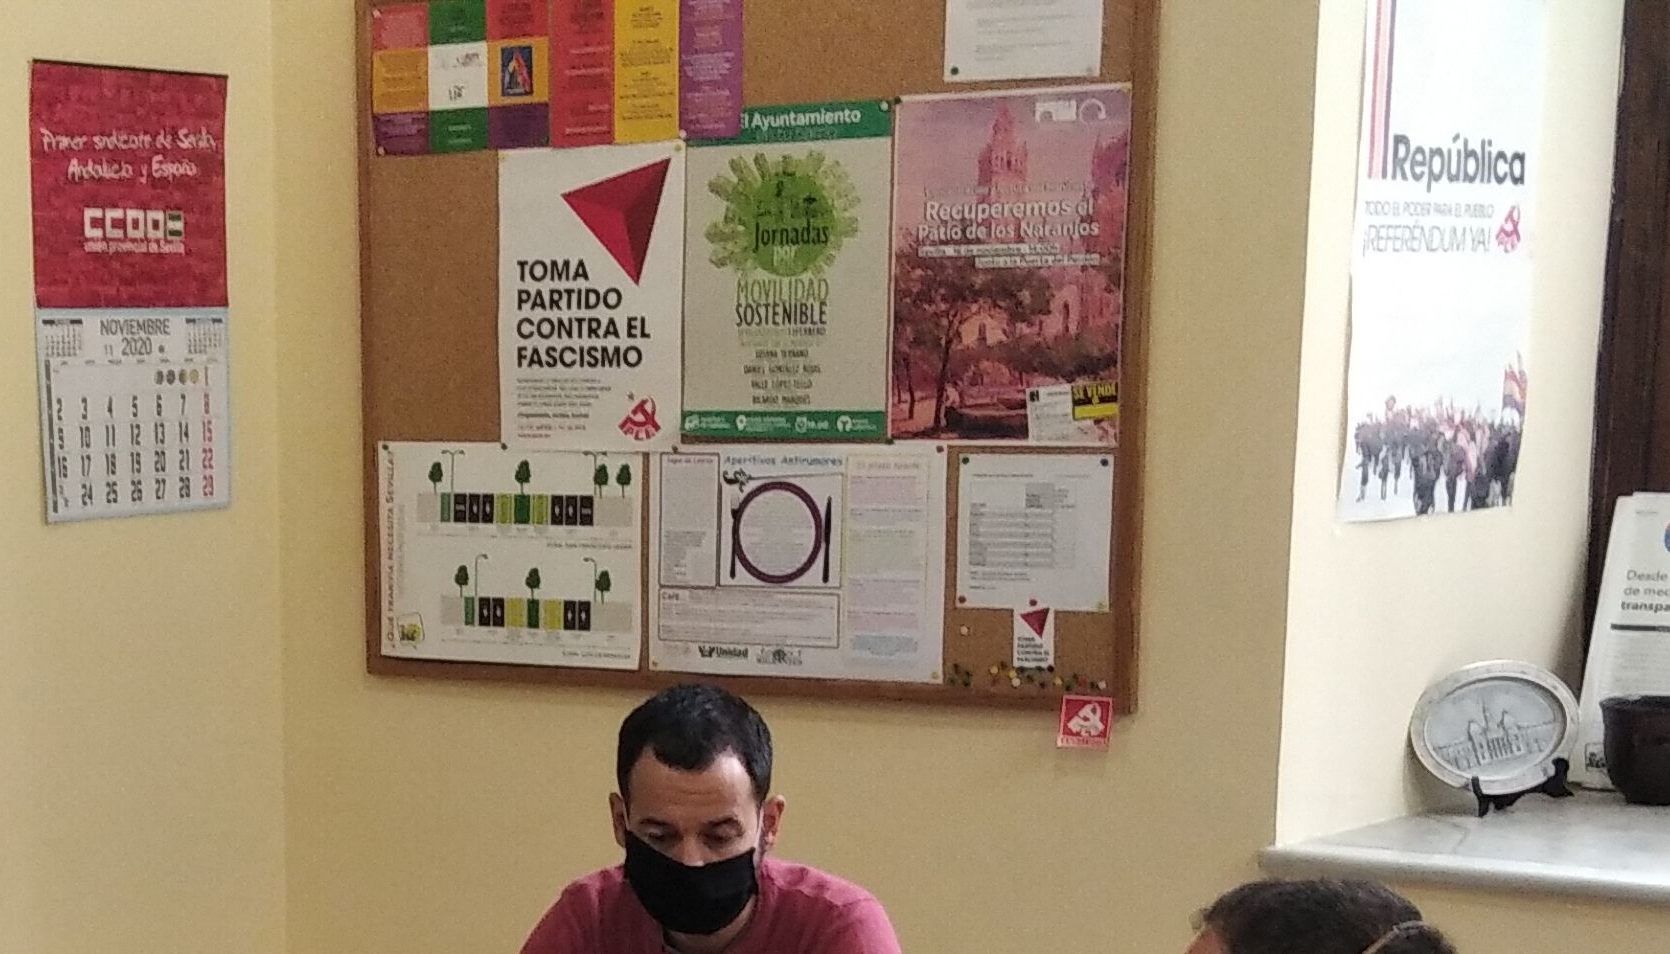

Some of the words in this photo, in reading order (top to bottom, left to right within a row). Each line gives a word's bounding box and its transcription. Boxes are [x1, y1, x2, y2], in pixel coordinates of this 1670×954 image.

[752, 108, 861, 131] Ayuntamiento
[1391, 132, 1526, 193] República
[925, 199, 1071, 223] Recuperemos
[1078, 198, 1093, 217] el
[83, 207, 165, 240] CCOO
[754, 219, 829, 253] Jornadas
[918, 223, 962, 241] Patio
[966, 222, 987, 240] de
[991, 221, 1015, 239] los
[1020, 220, 1100, 241] Naranjos
[1469, 225, 1491, 252] YA!
[517, 259, 589, 282] TOMA
[517, 287, 622, 311] PARTIDO
[736, 278, 828, 304] MOVILIDAD
[736, 301, 827, 327] SOSTENIBLE
[100, 318, 171, 336] NOVIEMBRE
[517, 317, 620, 339] CONTRA
[626, 316, 650, 339] EL
[121, 337, 153, 356] 2020
[517, 346, 642, 368] FASCISMO
[131, 395, 138, 418] 5
[156, 394, 162, 417] 6
[180, 393, 186, 415] 7
[80, 426, 91, 449] 10
[105, 424, 116, 447] 11
[130, 423, 141, 446] 12
[154, 422, 165, 445] 13
[179, 421, 189, 443] 14
[202, 420, 213, 443] 15
[57, 456, 68, 479] 16
[81, 454, 91, 477] 17
[105, 453, 116, 476] 18
[130, 452, 141, 474] 19
[154, 450, 166, 473] 20
[179, 449, 190, 471] 21
[202, 448, 214, 470] 22
[81, 483, 93, 506] 24
[106, 481, 118, 504] 25
[131, 479, 143, 502] 26
[155, 478, 166, 500] 27
[179, 476, 191, 499] 28
[1626, 569, 1668, 582] Desde
[1624, 586, 1640, 597] de
